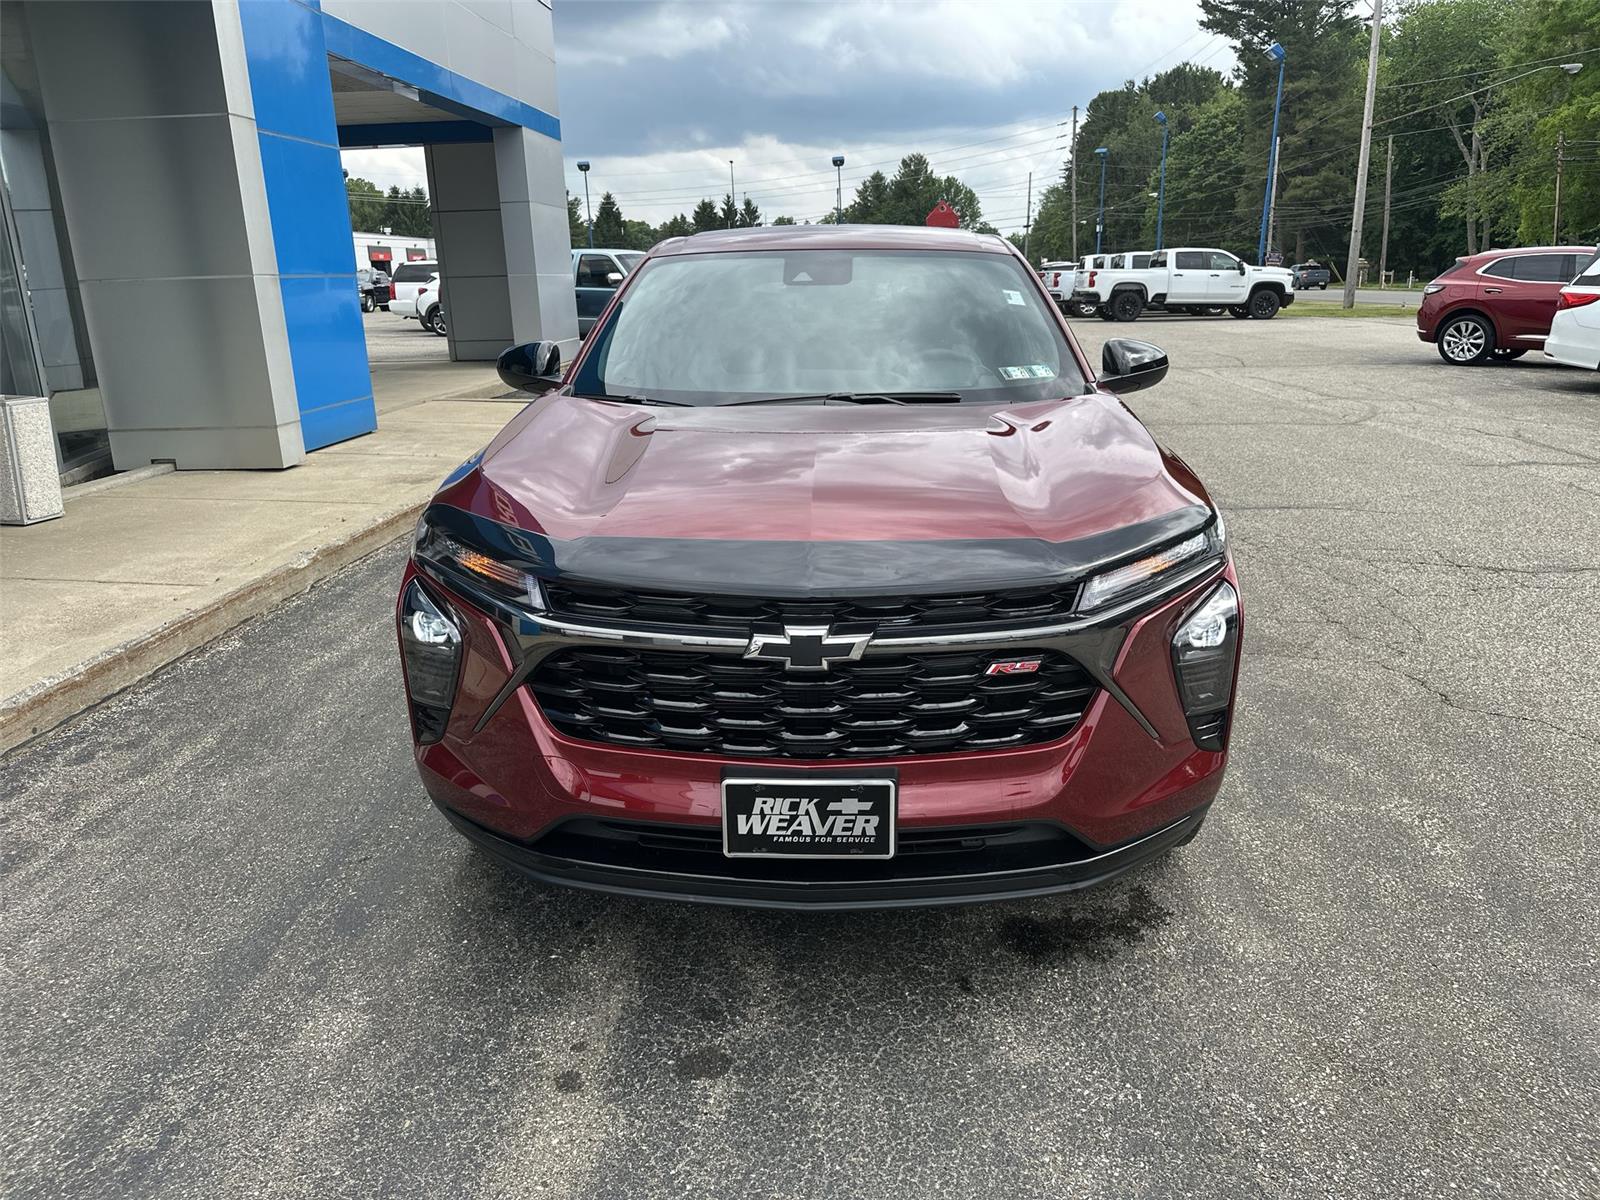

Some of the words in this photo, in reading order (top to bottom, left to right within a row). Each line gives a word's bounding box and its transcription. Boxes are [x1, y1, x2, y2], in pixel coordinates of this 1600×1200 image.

[985, 660, 1041, 675] RS
[752, 797, 820, 815] RICK
[737, 814, 880, 836] WEAVER
